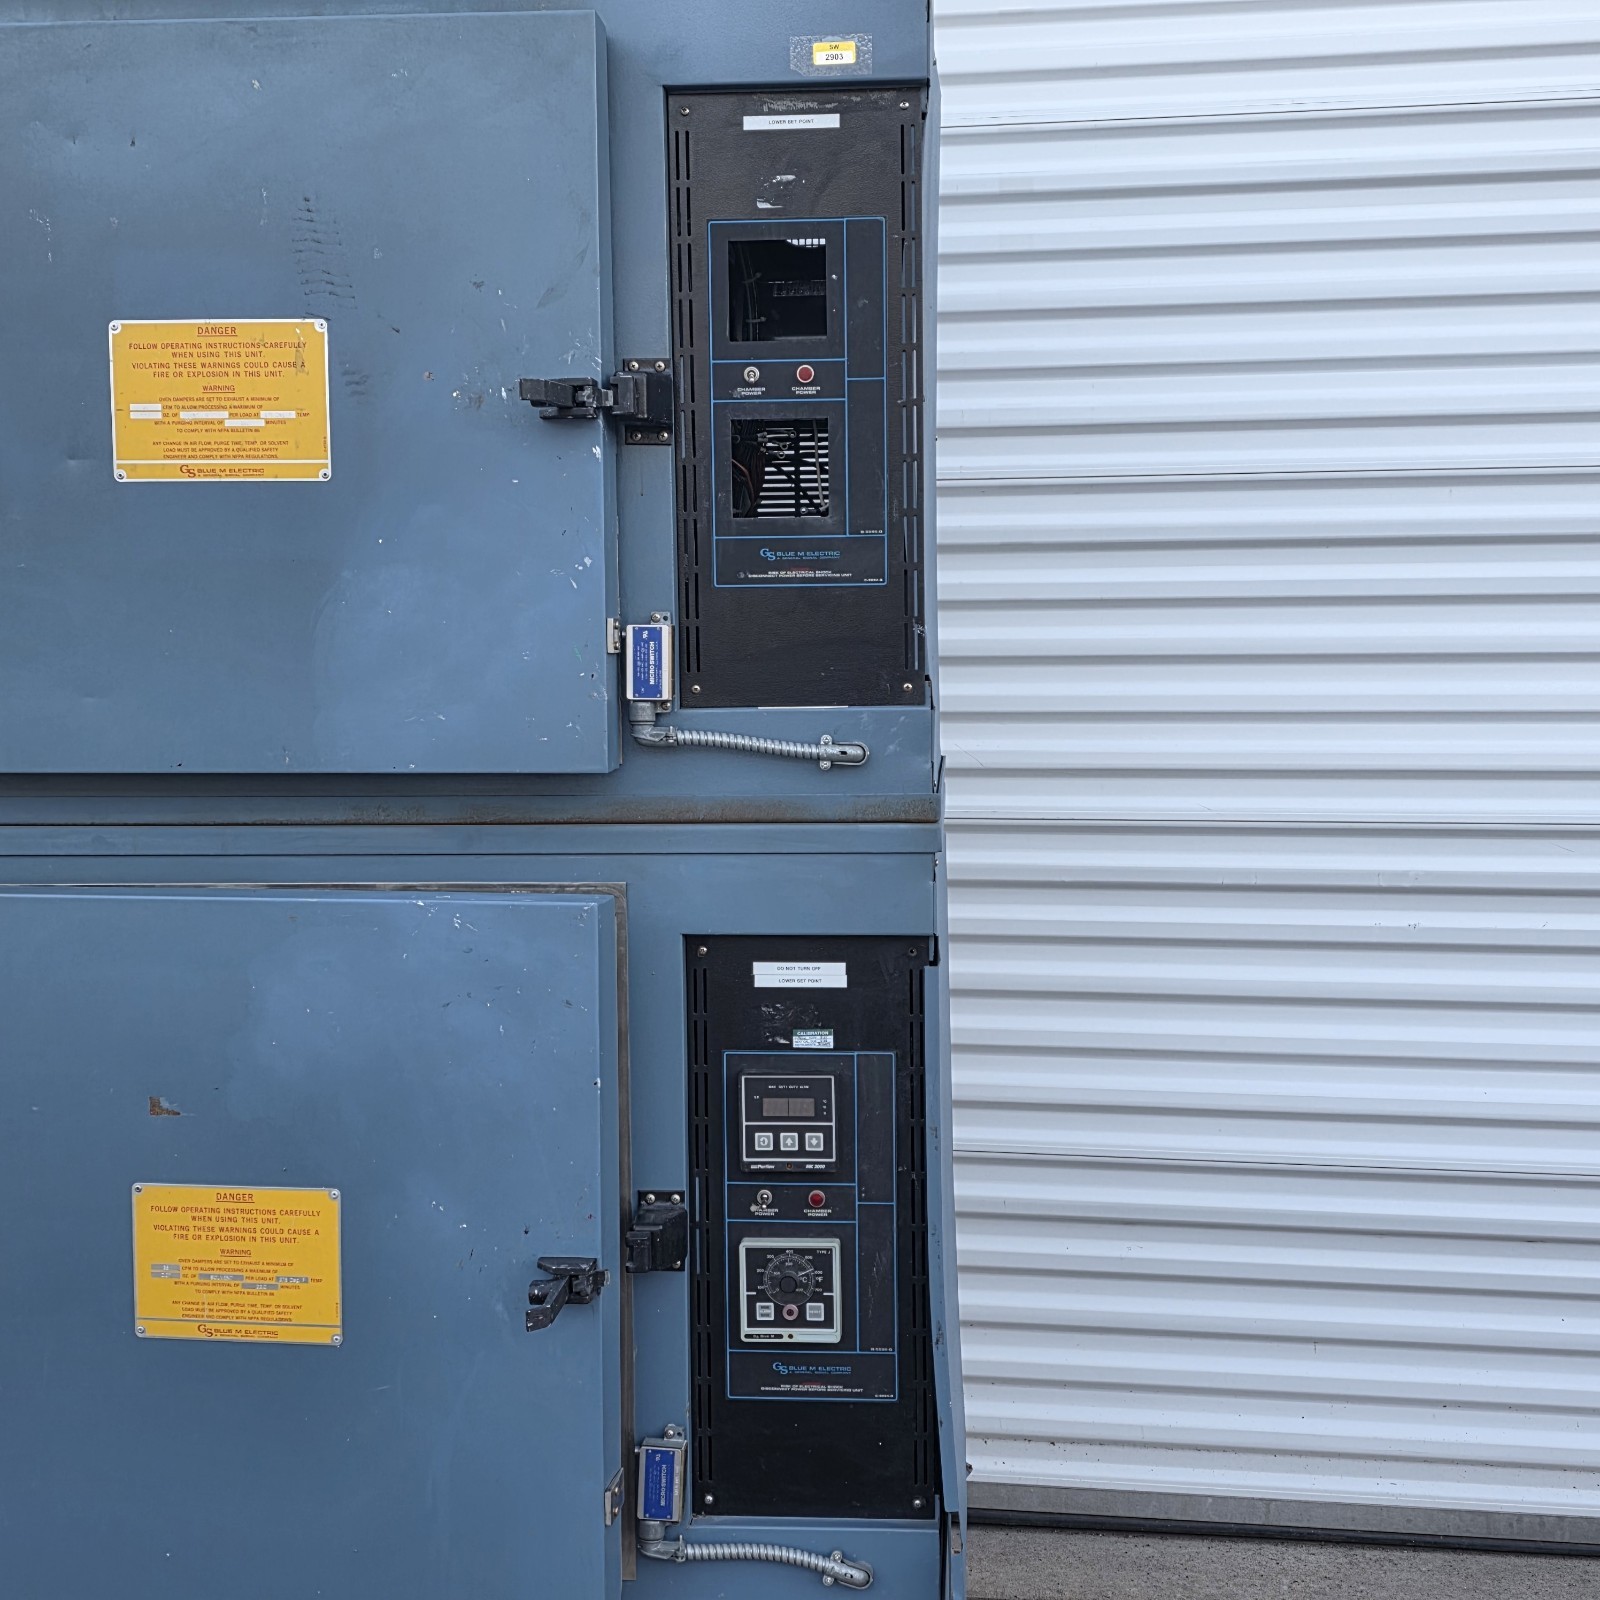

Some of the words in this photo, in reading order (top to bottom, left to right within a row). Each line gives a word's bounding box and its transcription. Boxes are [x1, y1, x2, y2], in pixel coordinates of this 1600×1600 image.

[198, 327, 237, 335] DANGER
[129, 342, 158, 350] FOLLOW
[160, 342, 202, 350] OPERATING
[264, 341, 307, 349] CAREFULLY
[132, 362, 170, 370] VIOLATING
[180, 464, 196, 478] GS
[760, 548, 776, 561] GS
[216, 1192, 254, 1202] DANGER
[224, 1208, 276, 1216] INSTRUCTIONS
[153, 1224, 190, 1232] VIOLATING
[219, 1226, 257, 1234] WARNINGS
[198, 1324, 213, 1338] GS
[772, 1362, 788, 1375] GS
